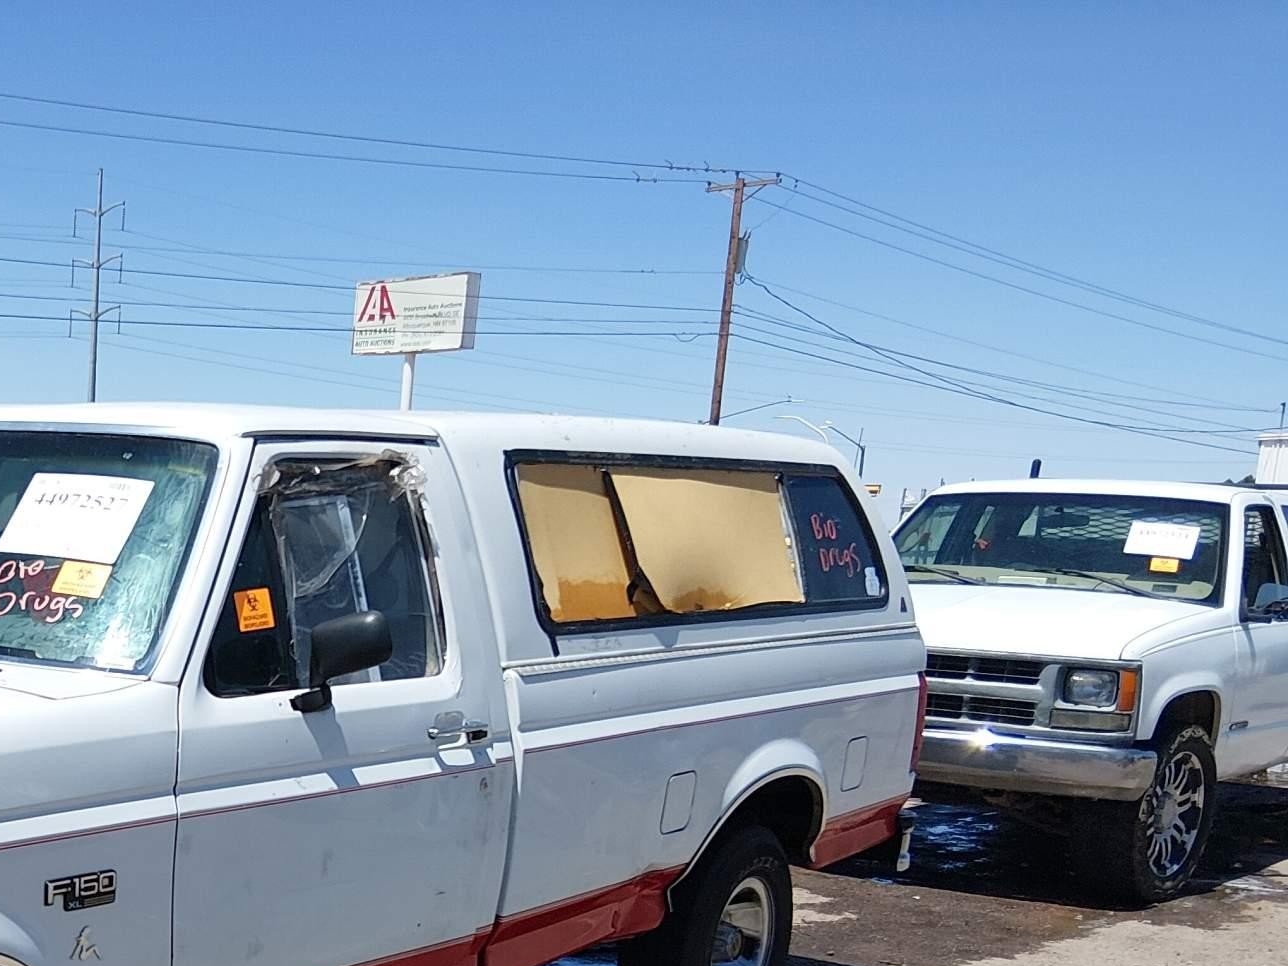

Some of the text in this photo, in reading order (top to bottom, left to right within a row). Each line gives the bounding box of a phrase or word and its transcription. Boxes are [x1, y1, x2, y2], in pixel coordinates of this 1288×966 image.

[355, 327, 397, 337] INSURANCE
[355, 340, 369, 348] AUTO
[370, 338, 395, 347] AUCTIONS
[68, 901, 83, 909] XL
